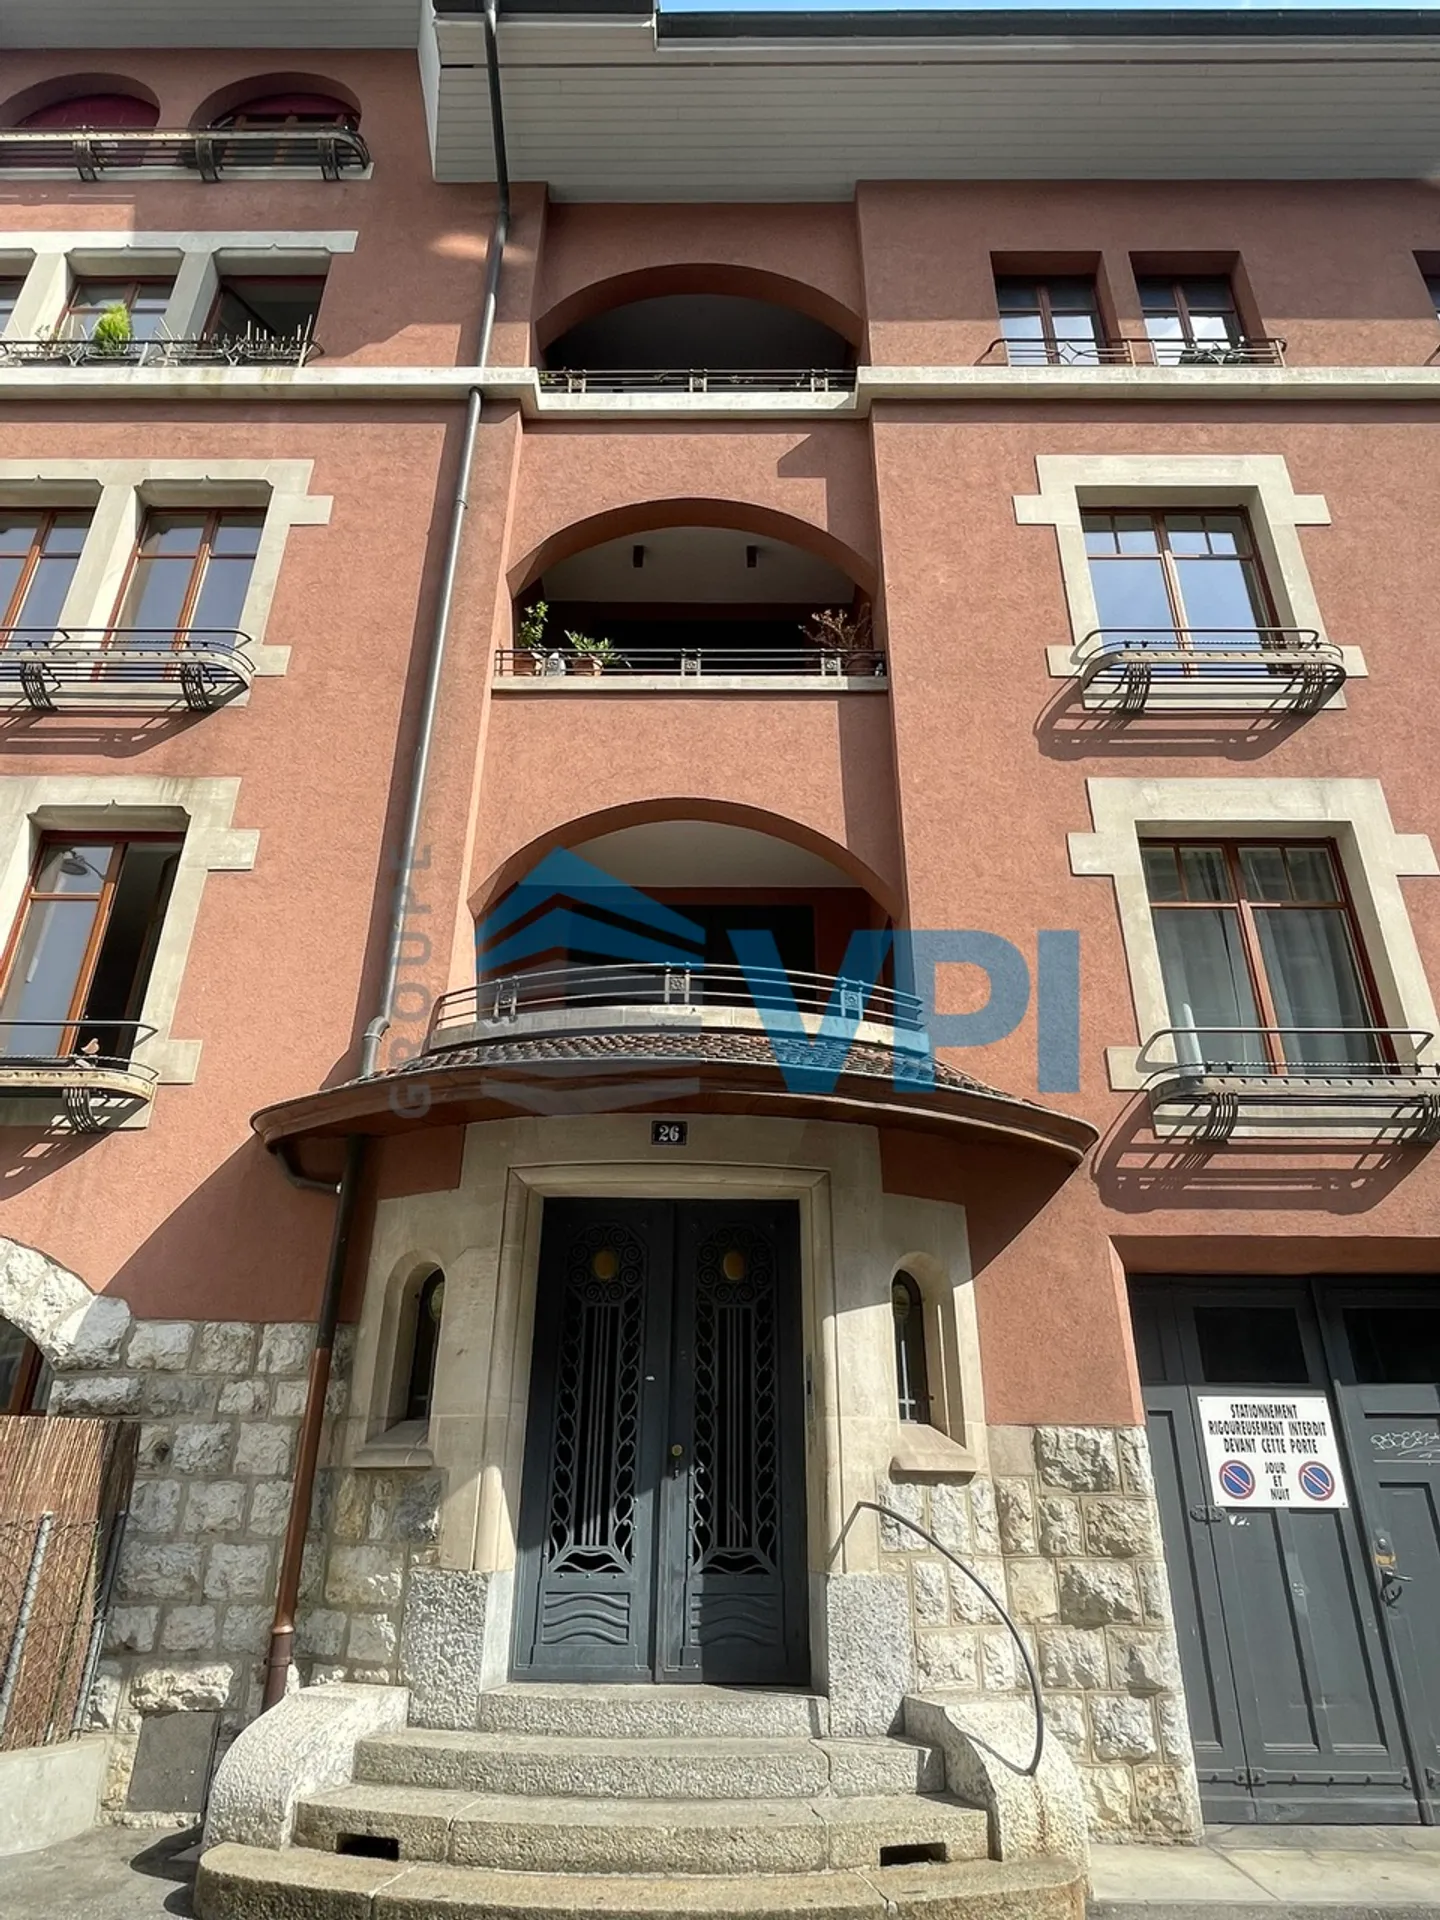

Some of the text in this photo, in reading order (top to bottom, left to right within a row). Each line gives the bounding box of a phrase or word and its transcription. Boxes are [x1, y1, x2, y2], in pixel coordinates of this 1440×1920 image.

[658, 1125, 680, 1142] 26
[1230, 1404, 1298, 1419] STATIONNEMENT
[1208, 1420, 1327, 1436] RIGOUREUSEMENT INTERDIT
[1223, 1438, 1319, 1454] DEVANT CETTE PORTE
[1264, 1462, 1287, 1474] JOUR
[1272, 1475, 1282, 1487] ET
[1270, 1488, 1290, 1501] NUIT
